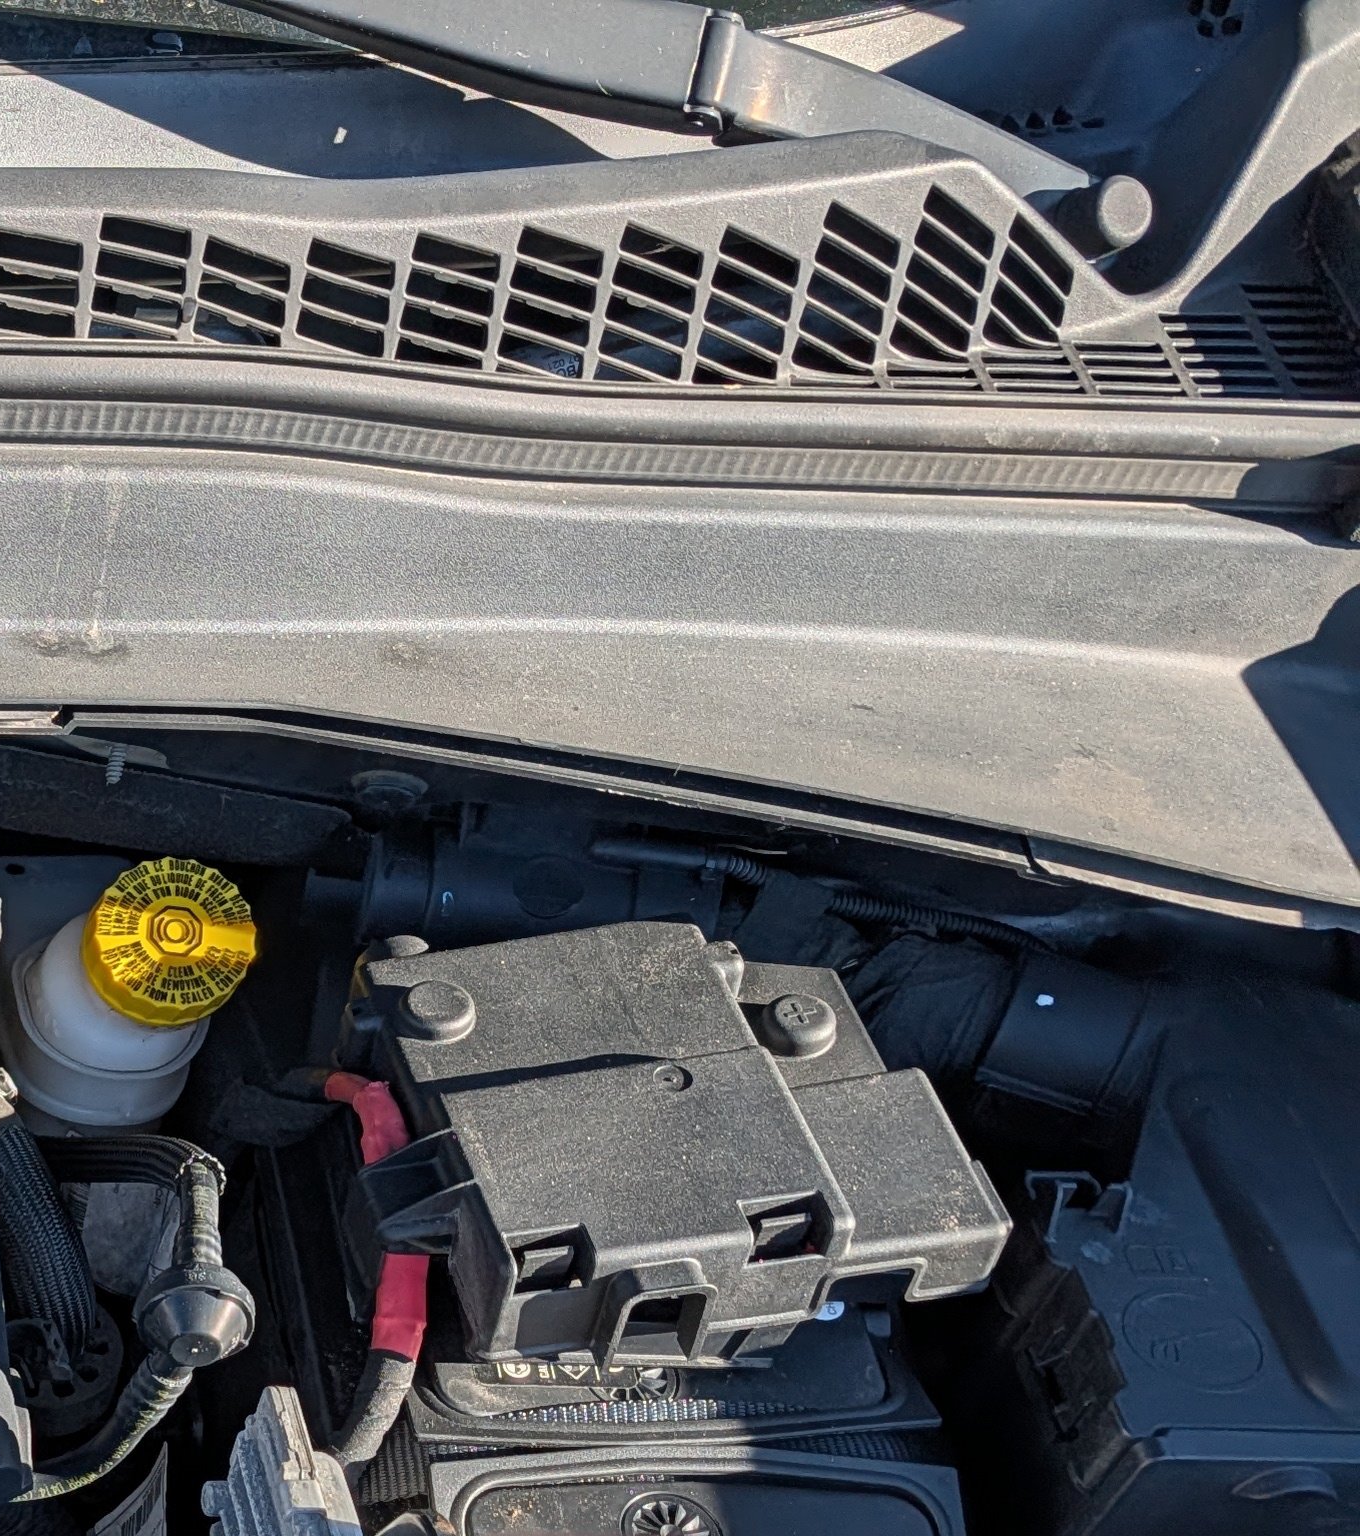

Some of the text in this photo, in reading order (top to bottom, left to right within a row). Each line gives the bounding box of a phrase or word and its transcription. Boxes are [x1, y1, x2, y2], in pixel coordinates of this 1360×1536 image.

[154, 861, 164, 872] CE
[209, 872, 233, 893] AVANT
[118, 944, 132, 963] CAP
[128, 960, 158, 987] BEFORE
[207, 967, 223, 984] USE
[220, 948, 235, 974] ONLY
[118, 967, 141, 992] FLUID
[143, 986, 168, 1003] FROM
[171, 993, 177, 1004] A
[180, 989, 215, 1005] SEALED
[217, 951, 250, 992] CONTAINER
[168, 965, 195, 978] CLEAN
[195, 946, 222, 973] FILLER
